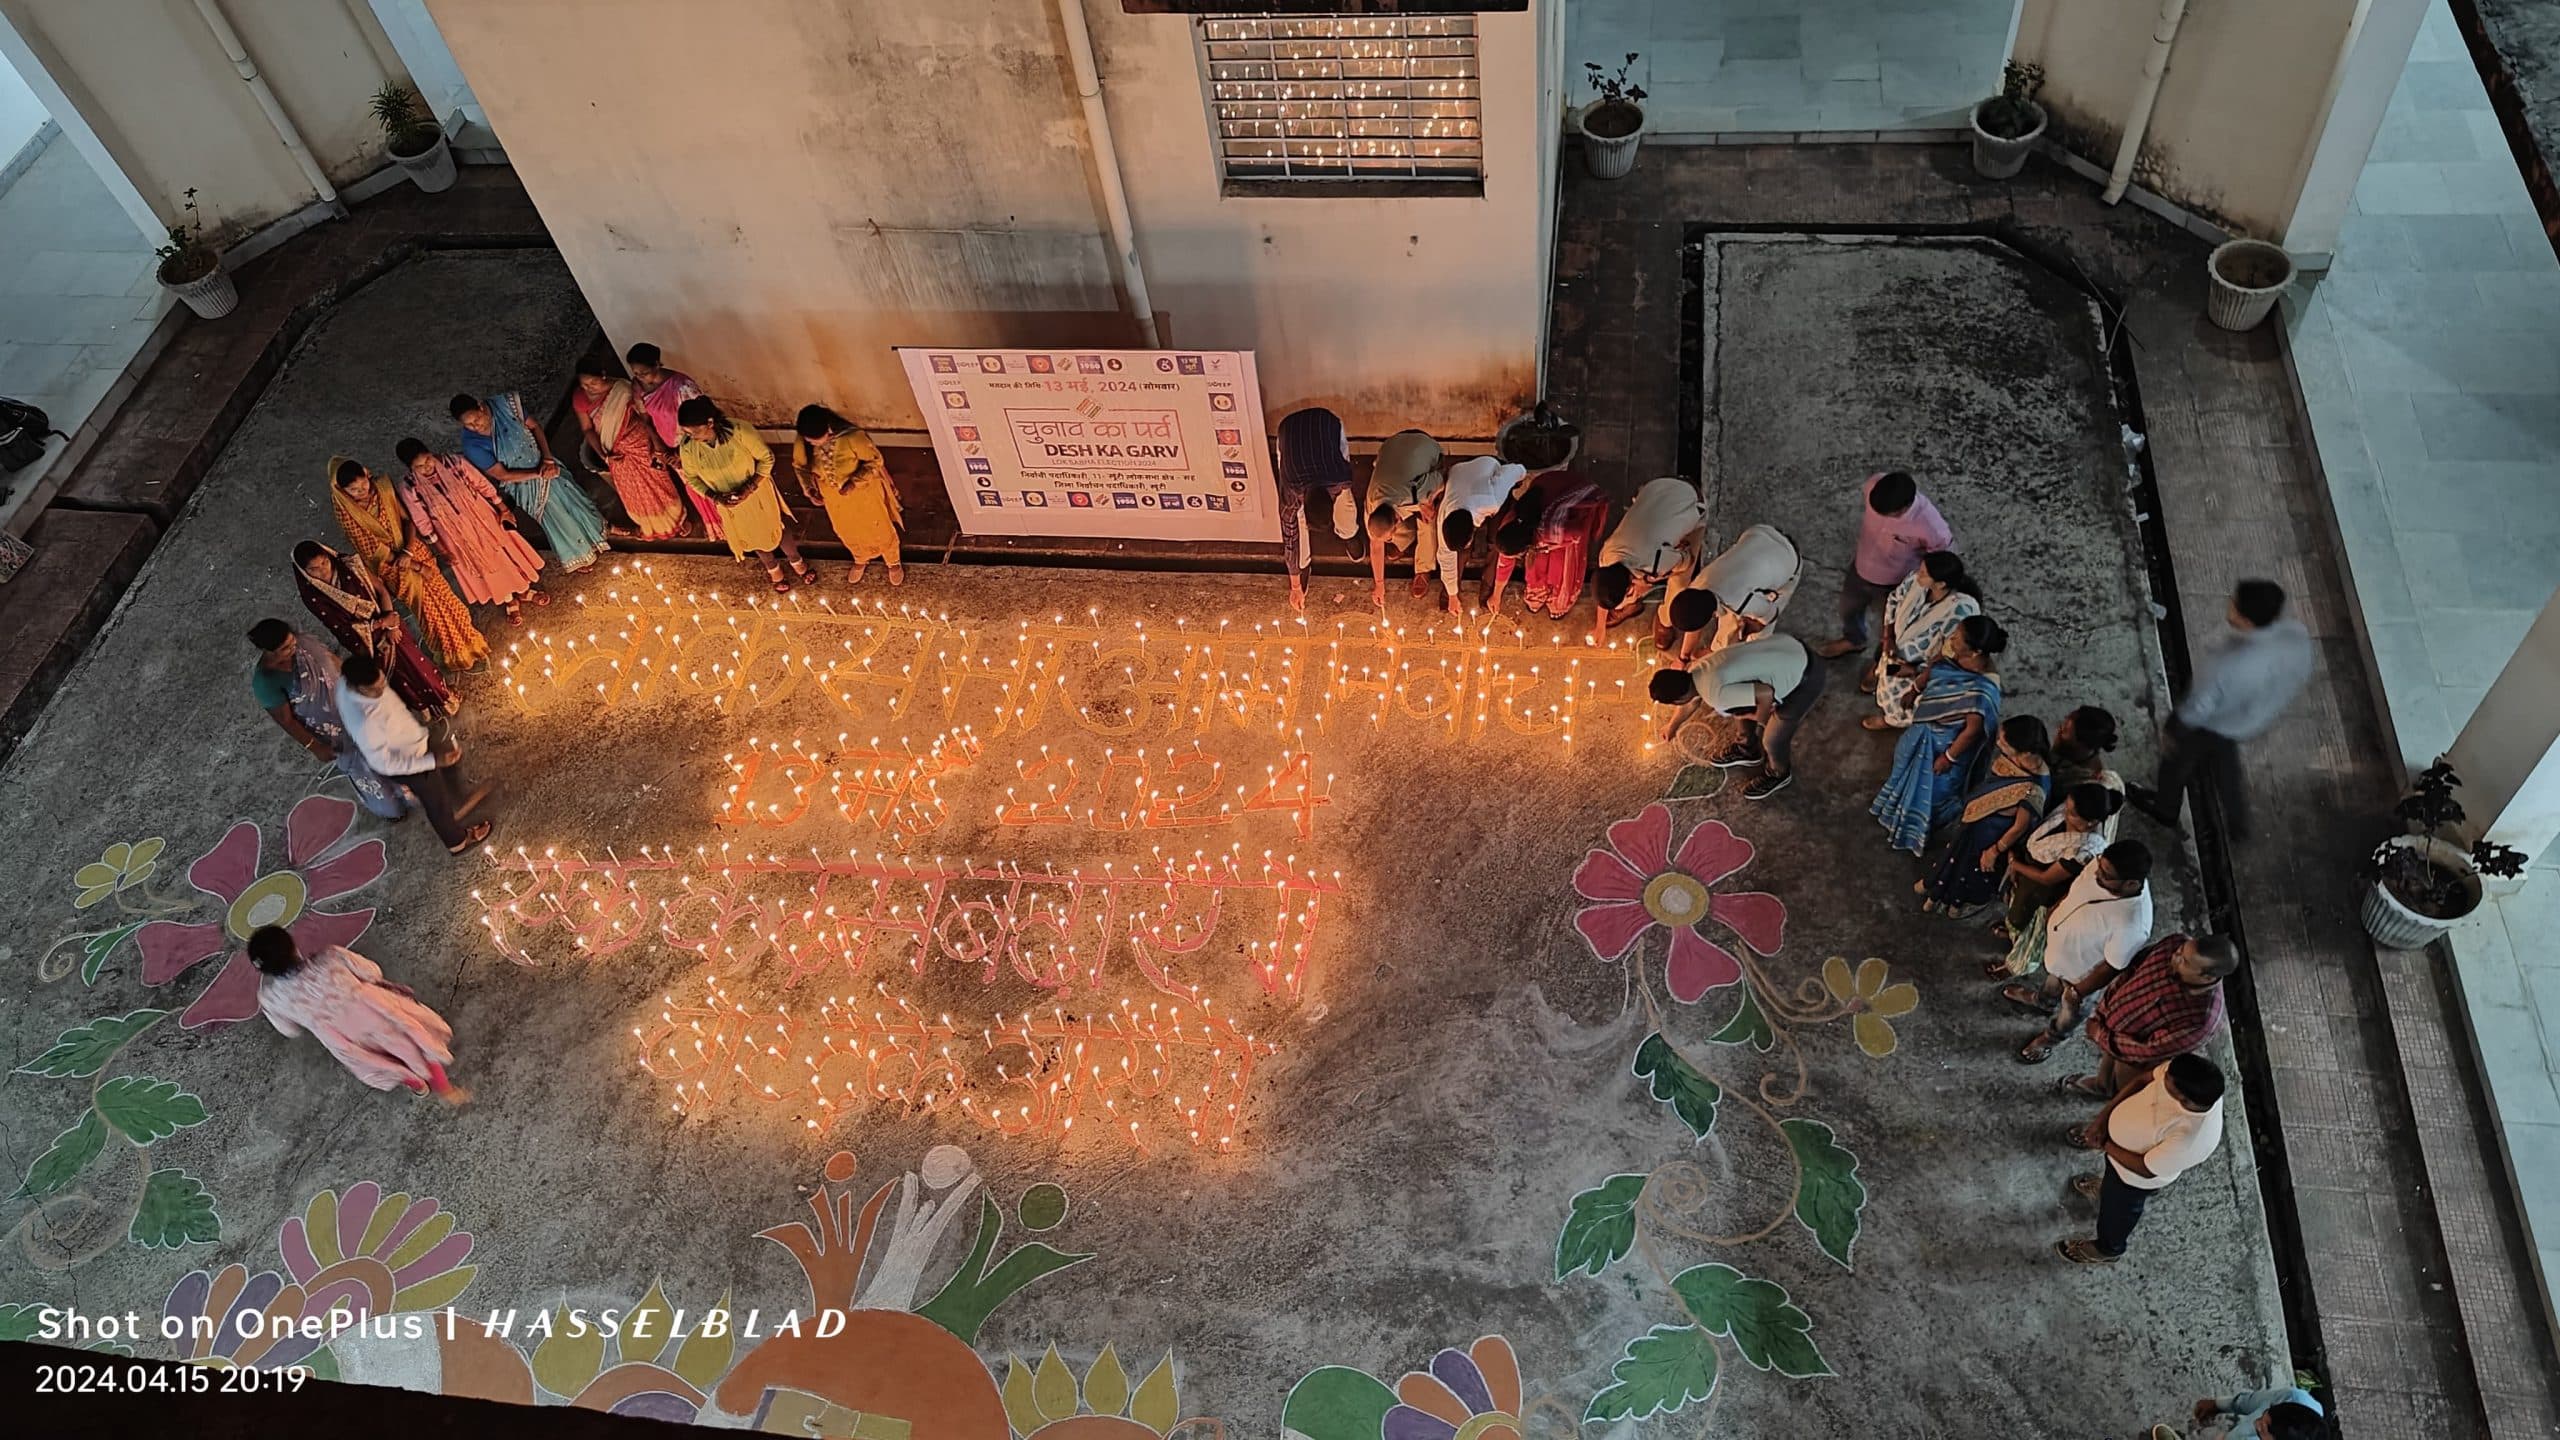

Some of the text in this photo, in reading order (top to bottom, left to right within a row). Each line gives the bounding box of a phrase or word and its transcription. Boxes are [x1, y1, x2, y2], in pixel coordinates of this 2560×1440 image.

[1044, 380, 1063, 392] 13
[1100, 381, 1137, 393] 2024
[1139, 380, 1181, 392] (सोमवार)
[1016, 414, 1171, 444] चुनाव का पर्व
[1044, 444, 1179, 458] DESH KA GARV
[712, 728, 1336, 848] 13 मई 2024
[660, 850, 960, 990] कदम
